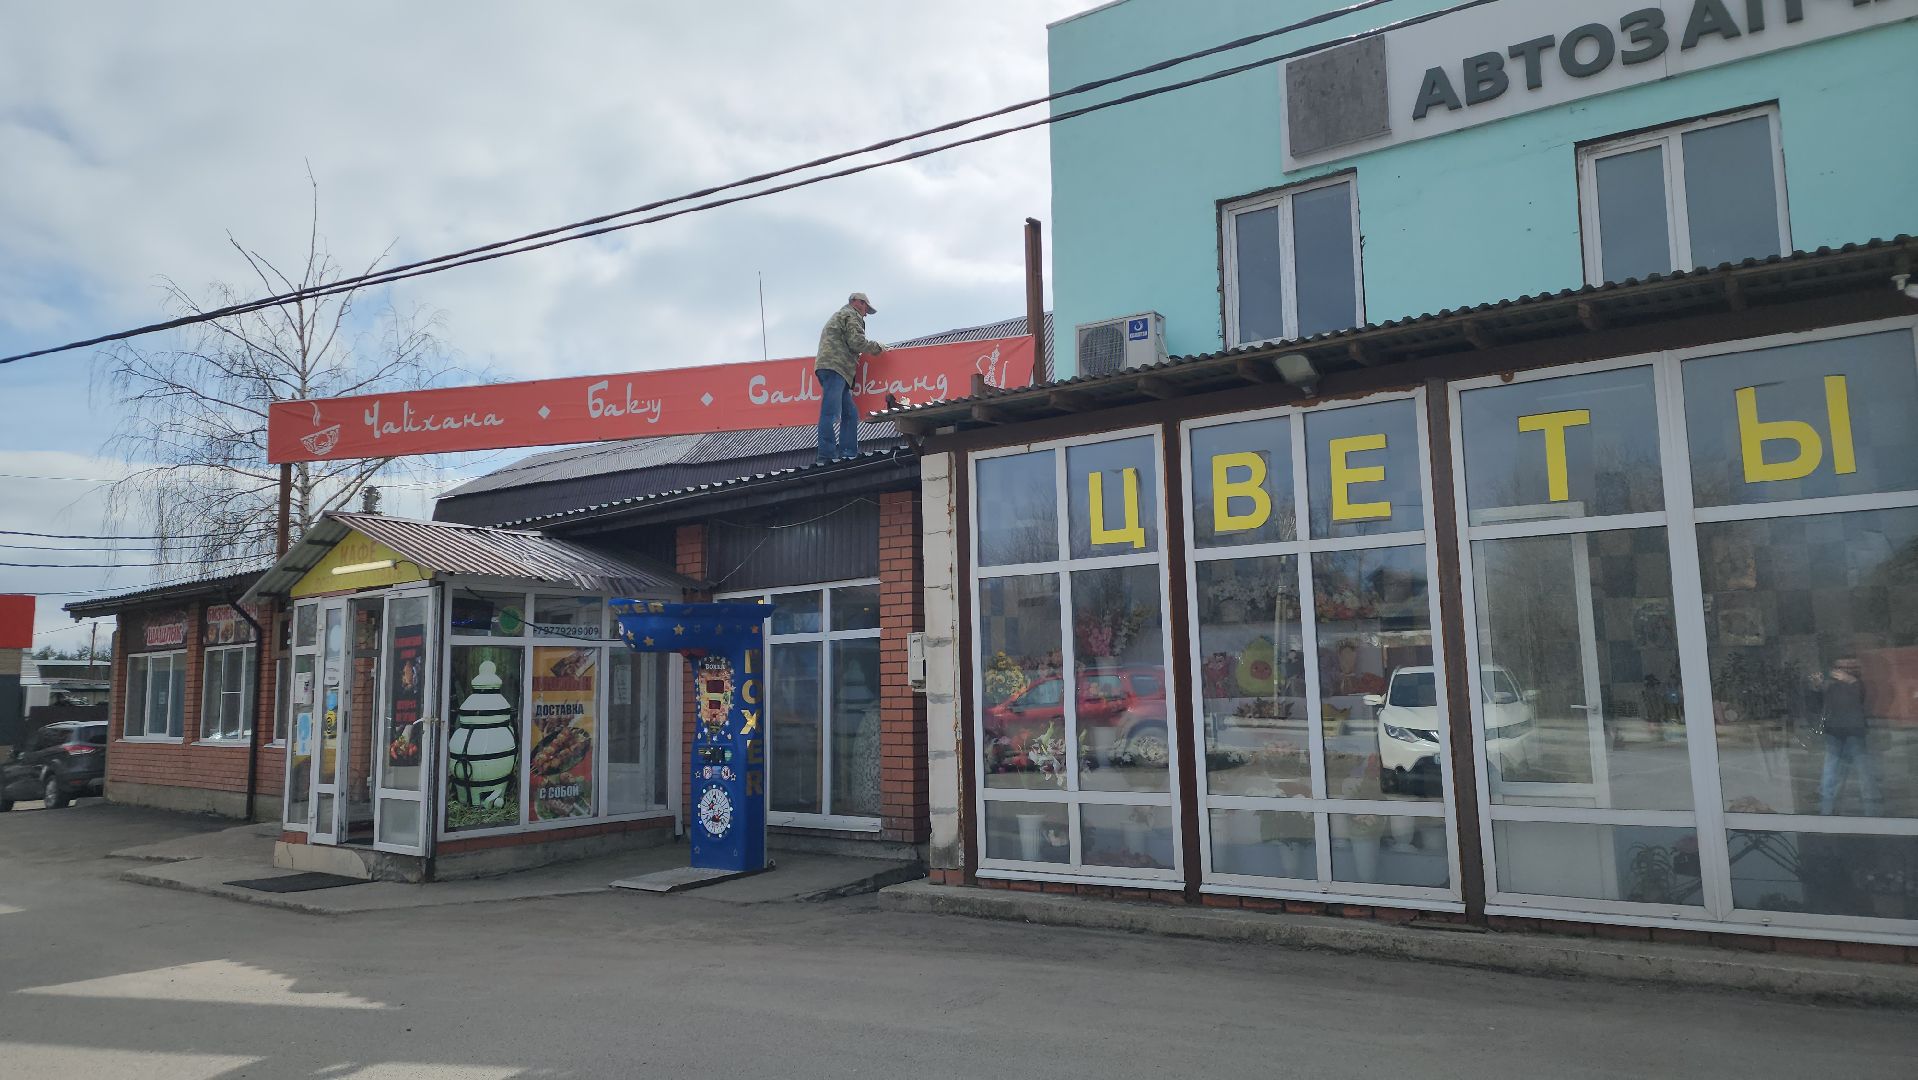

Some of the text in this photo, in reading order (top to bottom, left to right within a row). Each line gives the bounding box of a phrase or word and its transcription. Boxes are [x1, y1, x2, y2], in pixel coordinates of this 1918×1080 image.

[1412, 0, 1890, 121] АВТОЗАП
[363, 361, 949, 439] Чайхана Баку Самканд
[1088, 374, 1857, 549] ЦВЕТЫ
[535, 703, 585, 717] ДОСТАВКА
[739, 649, 764, 797] BOXER
[540, 784, 580, 799] С СОБОЙ
